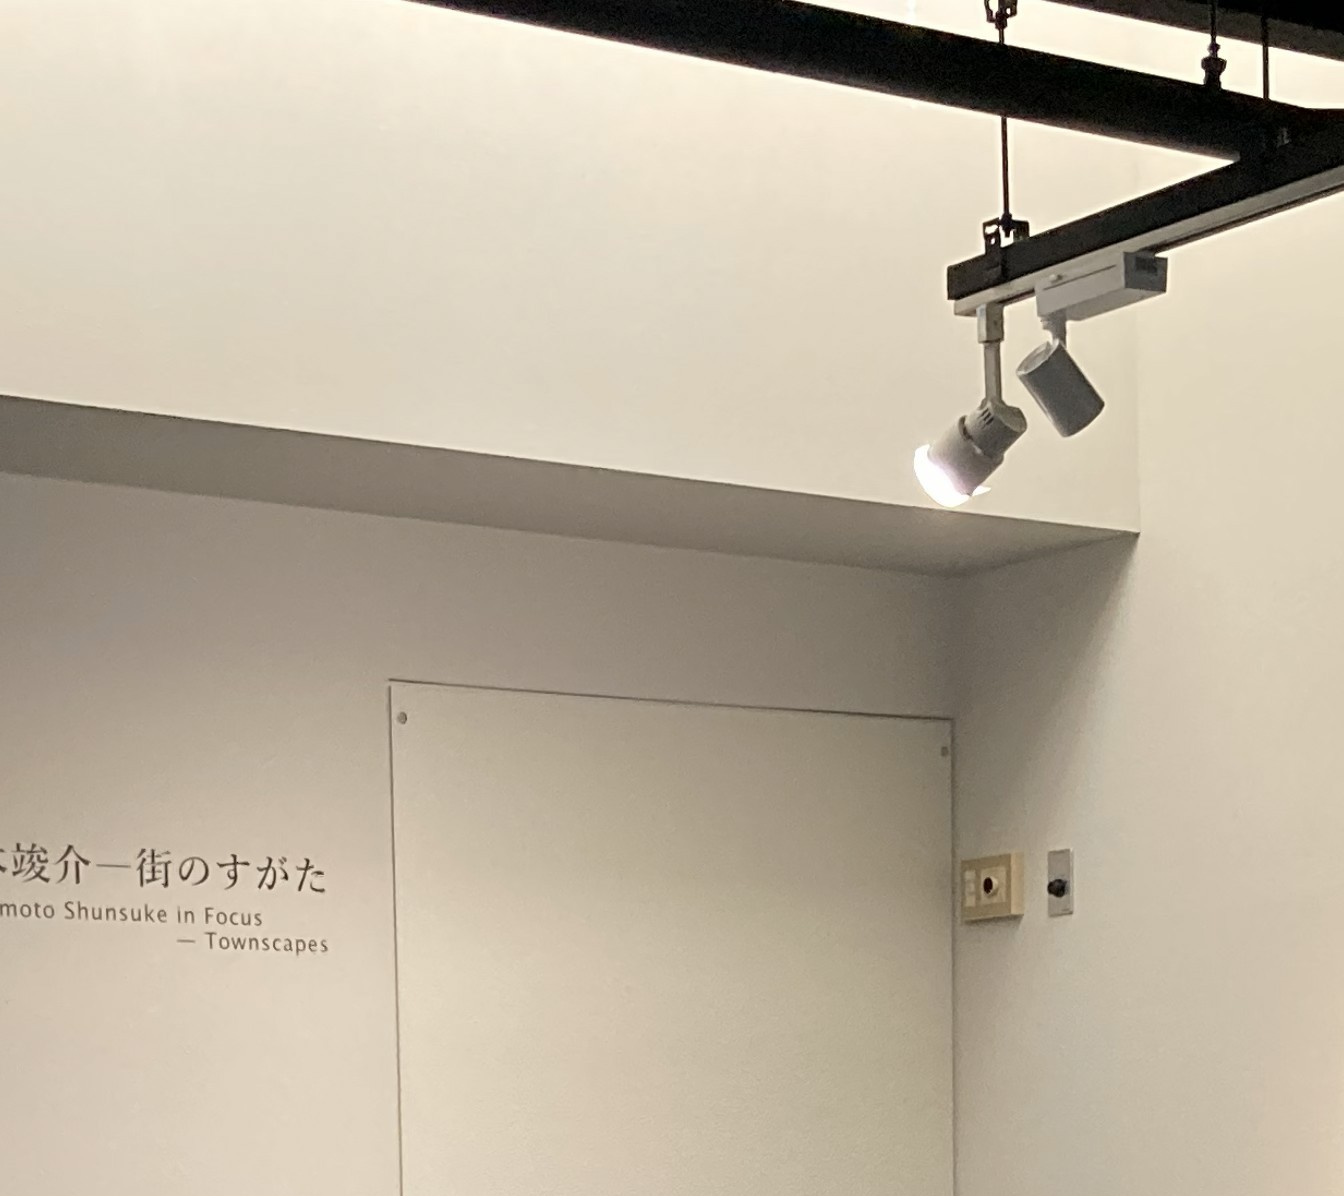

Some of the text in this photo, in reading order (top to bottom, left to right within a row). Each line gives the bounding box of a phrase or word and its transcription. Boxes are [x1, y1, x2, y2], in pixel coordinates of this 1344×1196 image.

[64, 901, 168, 923] Shunsuke
[176, 906, 196, 925] in
[204, 907, 263, 927] Focus
[205, 931, 329, 956] Townscapes
